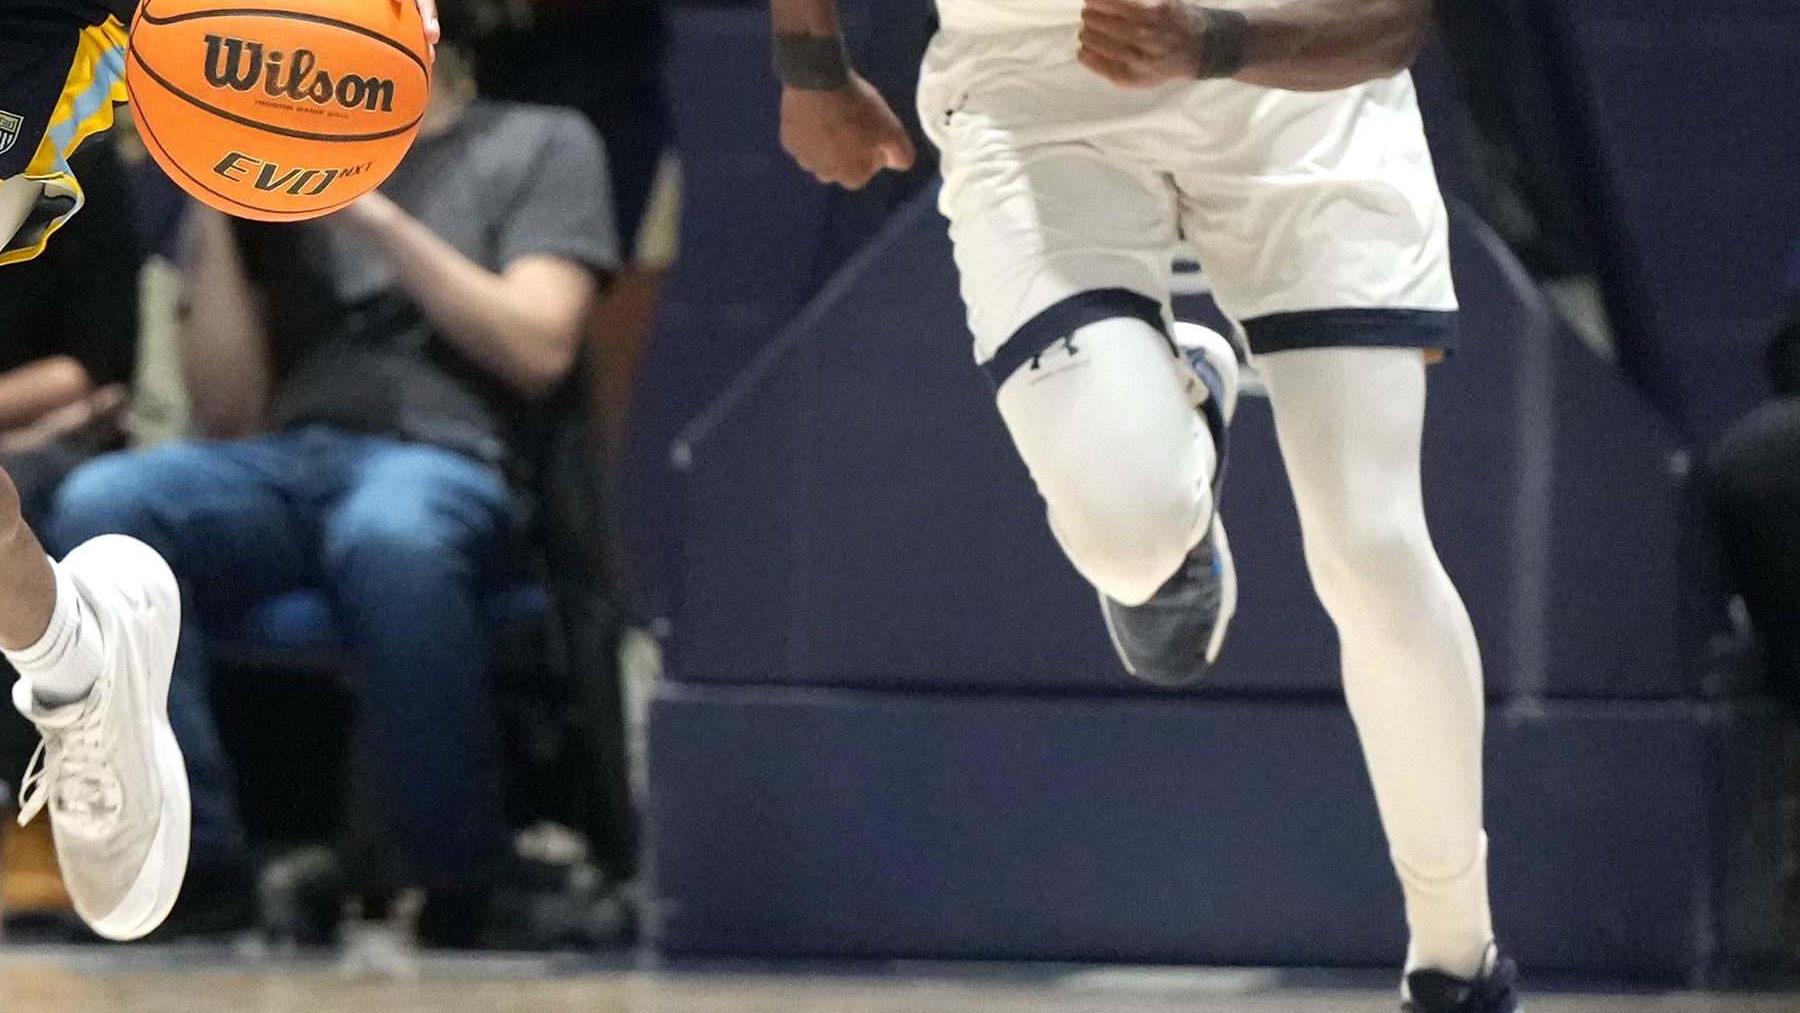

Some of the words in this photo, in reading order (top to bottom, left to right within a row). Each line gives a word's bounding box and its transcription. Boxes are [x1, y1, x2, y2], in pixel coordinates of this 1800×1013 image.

[204, 34, 395, 112] Wilson
[296, 106, 325, 116] GAME
[212, 151, 341, 196] EVO
[339, 161, 374, 179] NXT
